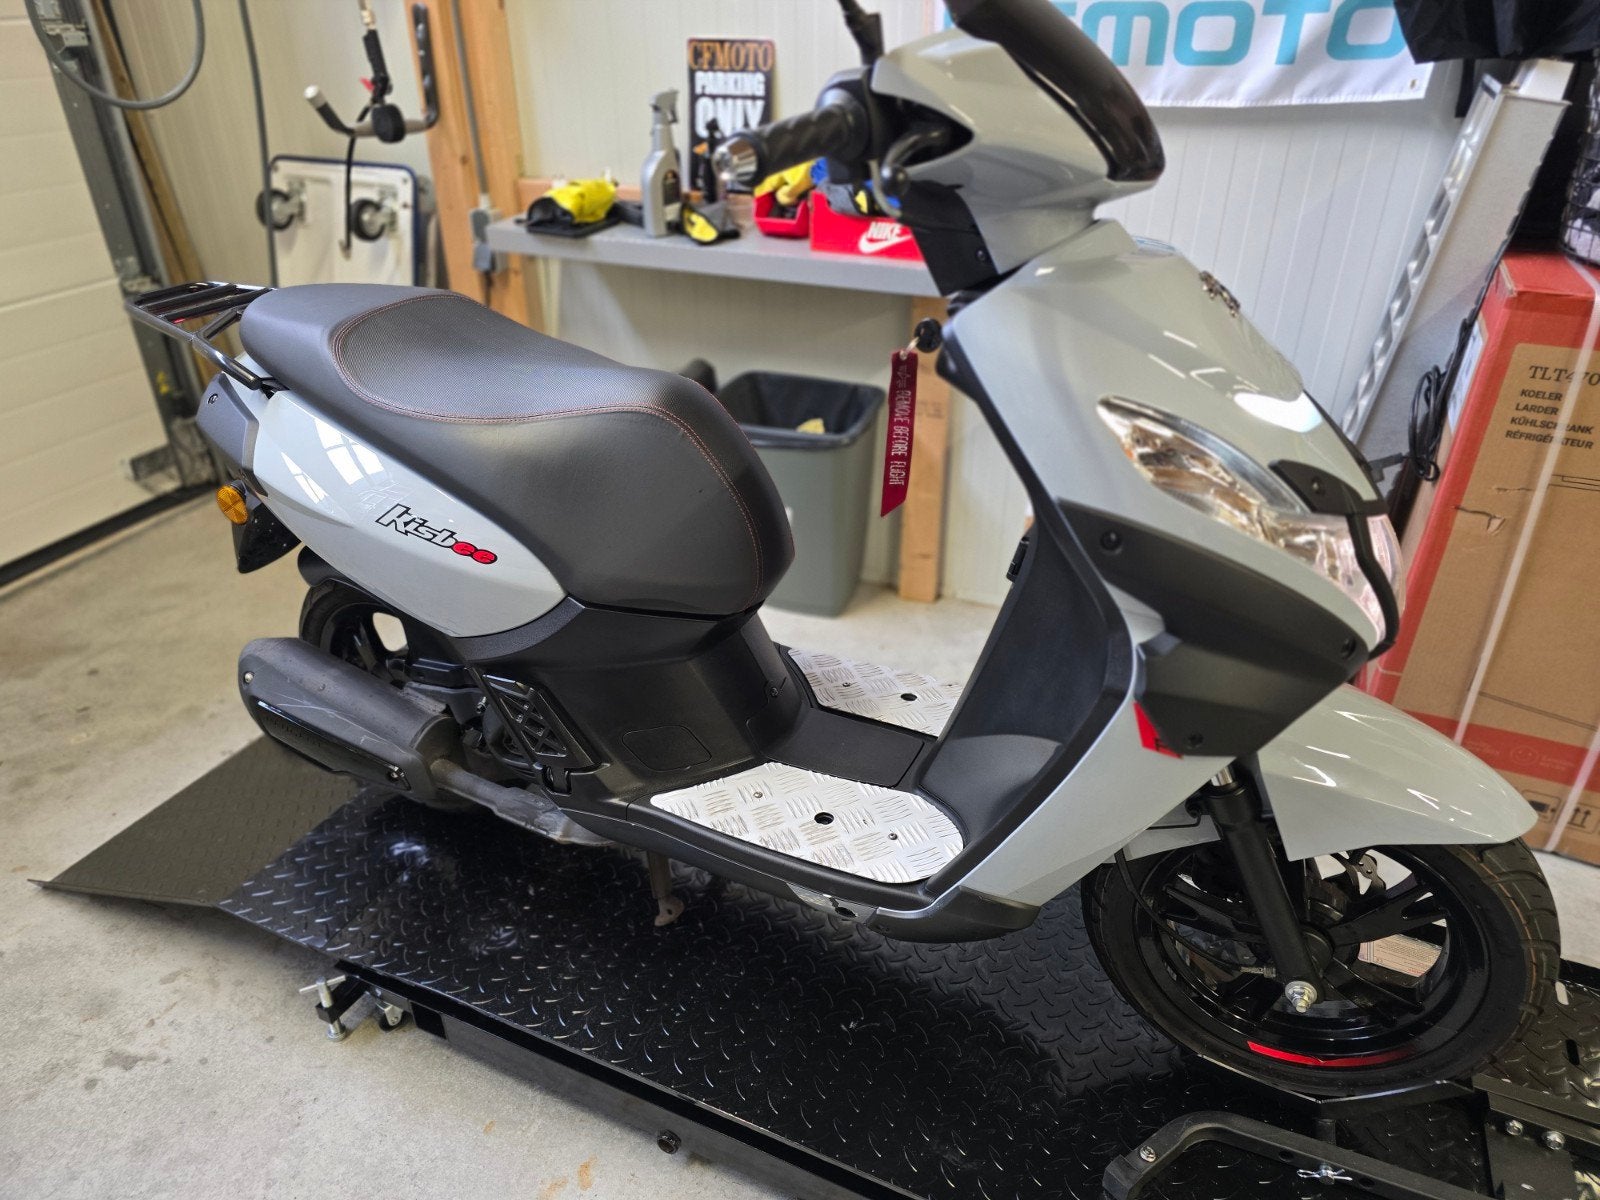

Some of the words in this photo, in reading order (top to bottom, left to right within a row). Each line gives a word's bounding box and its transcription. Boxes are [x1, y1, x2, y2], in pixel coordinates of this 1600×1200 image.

[944, 0, 1406, 66] MOTO
[689, 41, 774, 71] CFMOTO
[694, 71, 766, 97] PARKING
[694, 96, 765, 139] ONLY
[867, 222, 903, 240] NIKE
[894, 389, 912, 424] REMOVE
[1520, 389, 1563, 401] KOELER
[1515, 403, 1559, 415] LARDER
[1510, 416, 1594, 434] KÜHLSCANK
[891, 425, 910, 456] BEFORE
[888, 460, 907, 486] FLIGHT
